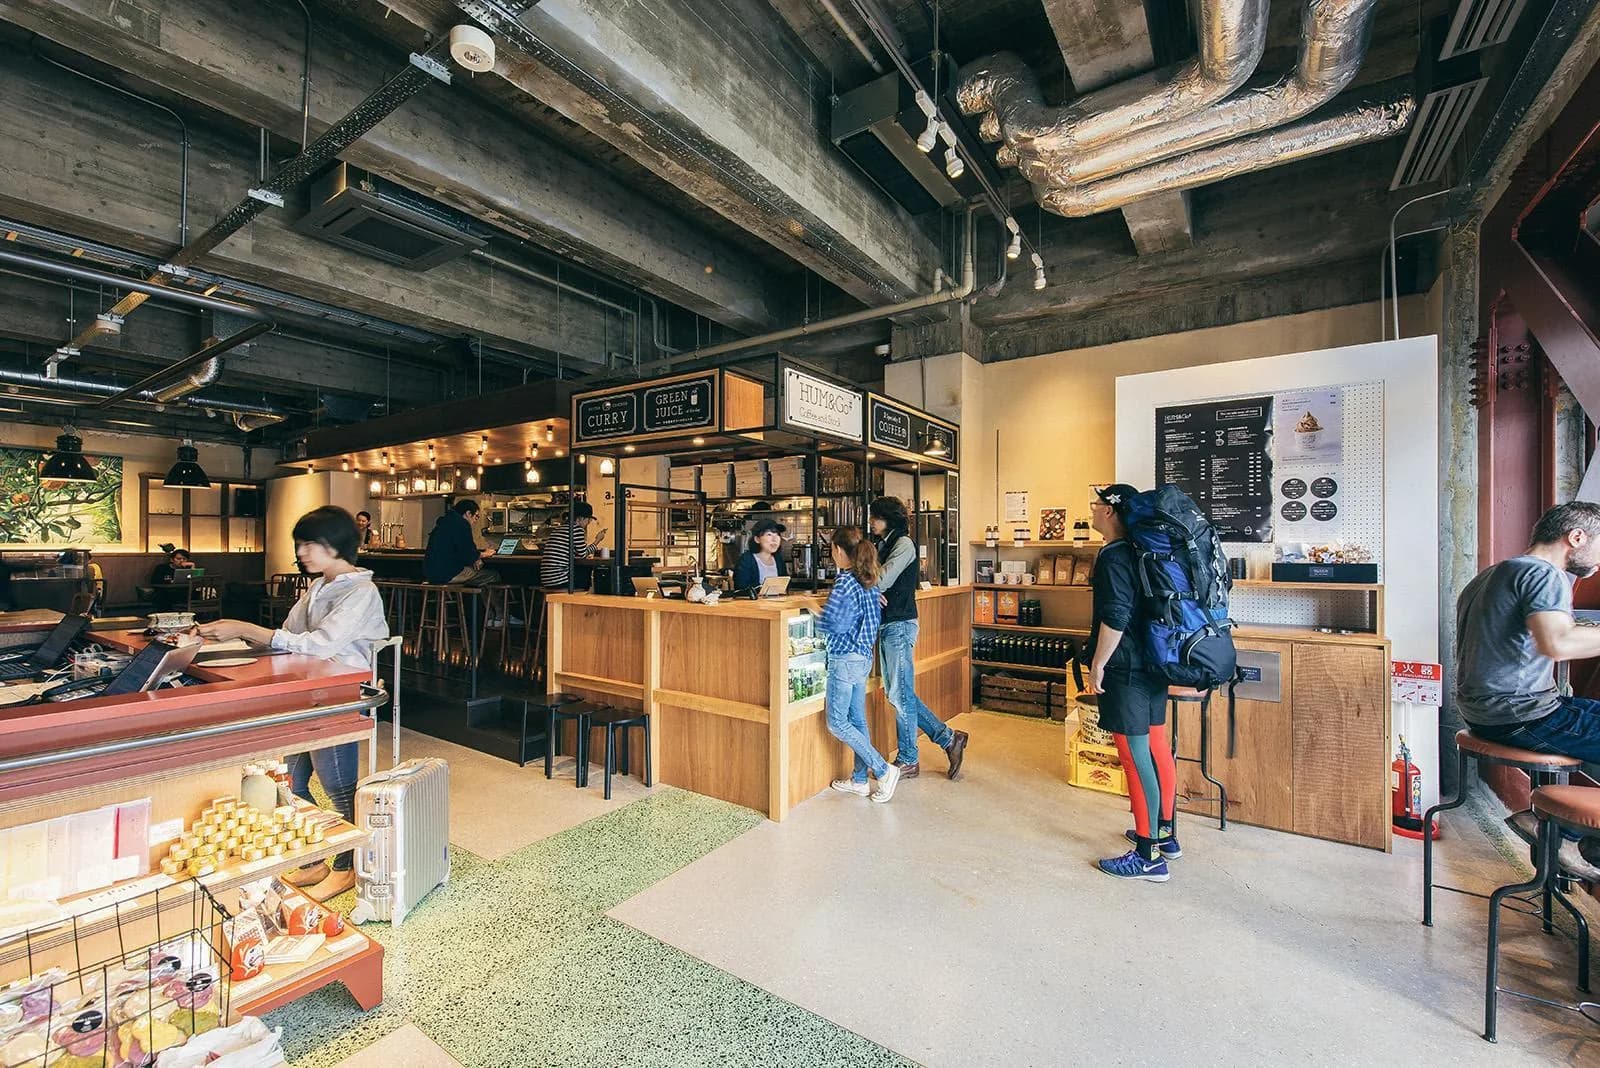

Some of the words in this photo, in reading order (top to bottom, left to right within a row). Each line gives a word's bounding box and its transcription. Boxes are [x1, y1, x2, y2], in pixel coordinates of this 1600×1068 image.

[655, 390, 688, 405] GREEN
[587, 410, 628, 428] CURRY
[655, 404, 684, 418] JUICE
[878, 420, 902, 437] COFFEE
